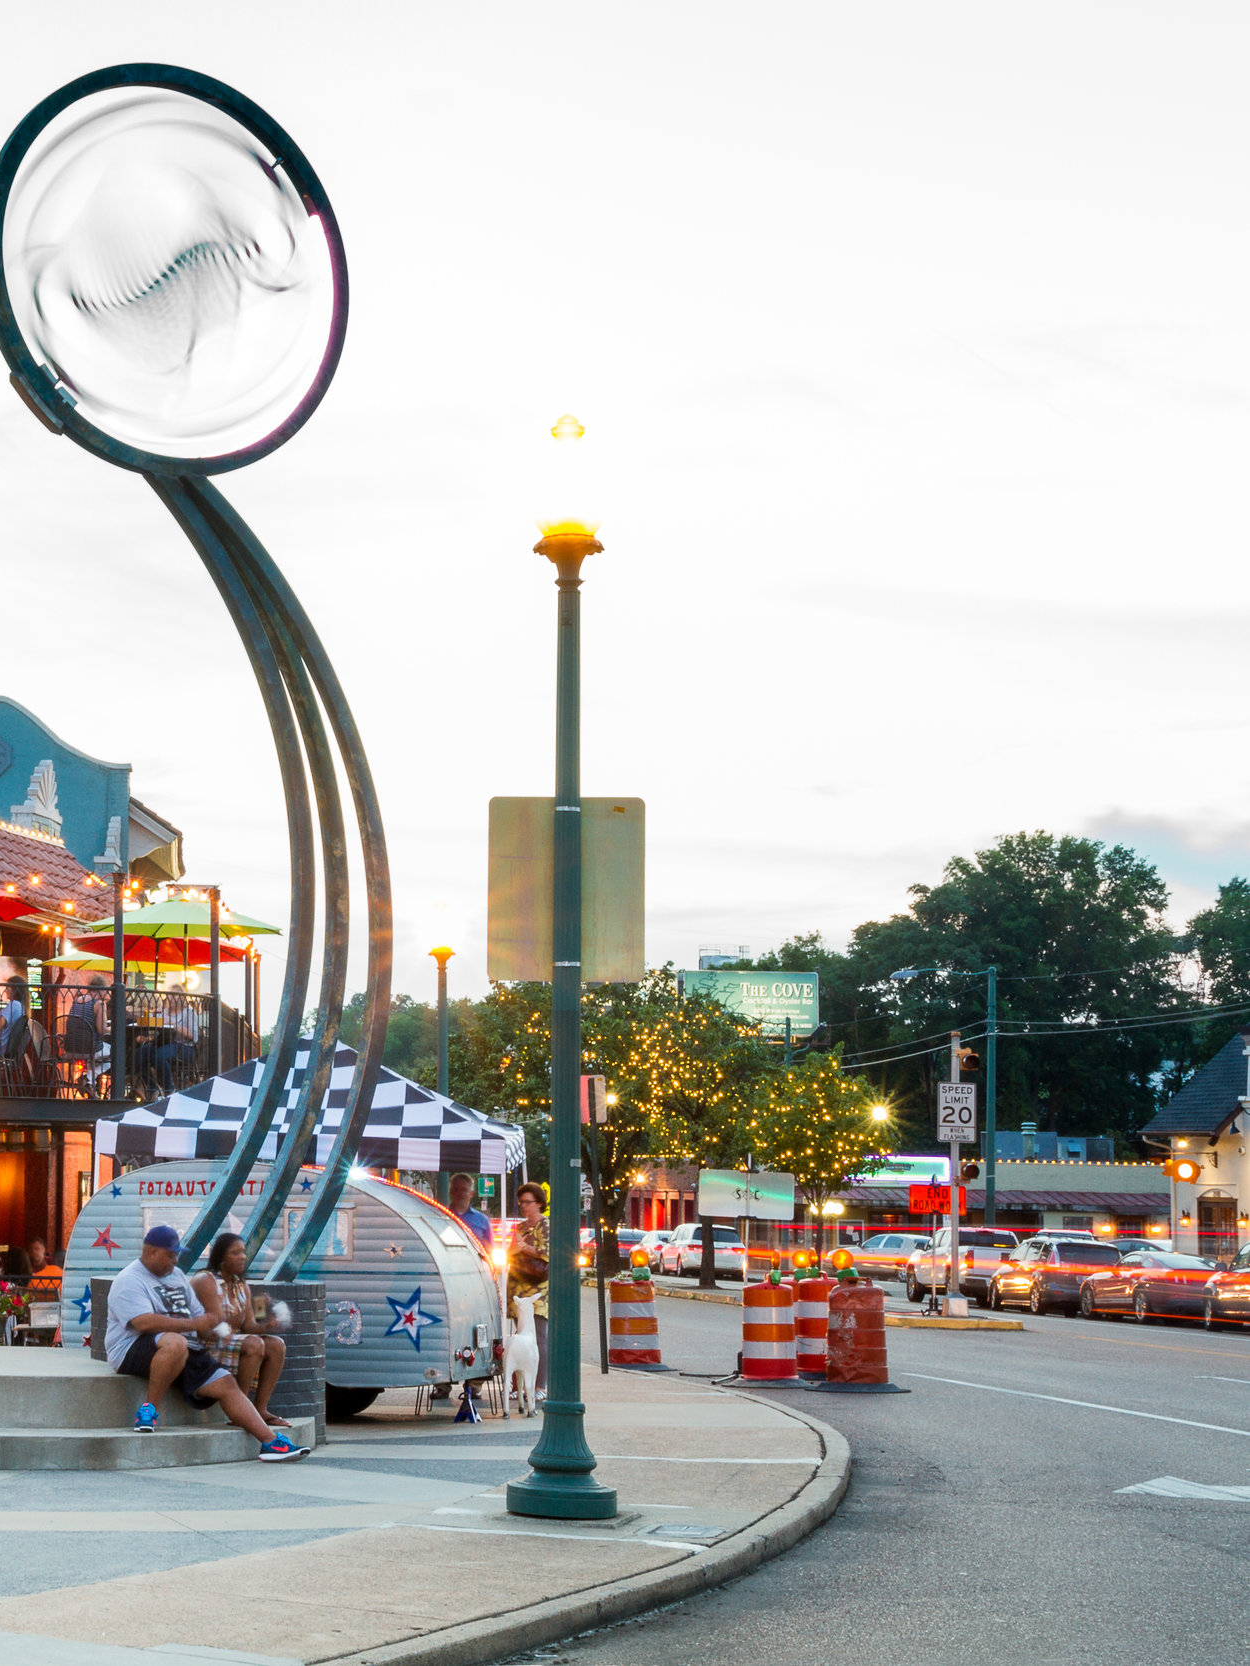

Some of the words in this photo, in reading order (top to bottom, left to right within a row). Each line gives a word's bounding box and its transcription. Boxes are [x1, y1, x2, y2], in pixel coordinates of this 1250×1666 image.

[772, 982, 814, 998] COVE
[941, 1085, 974, 1095] SPEED
[944, 1096, 970, 1105] LIMIT
[942, 1105, 972, 1124] 20
[943, 1133, 971, 1141] FLASHING
[927, 1187, 949, 1199] END
[913, 1199, 936, 1211] ROAD
[938, 1199, 963, 1211] WOK
